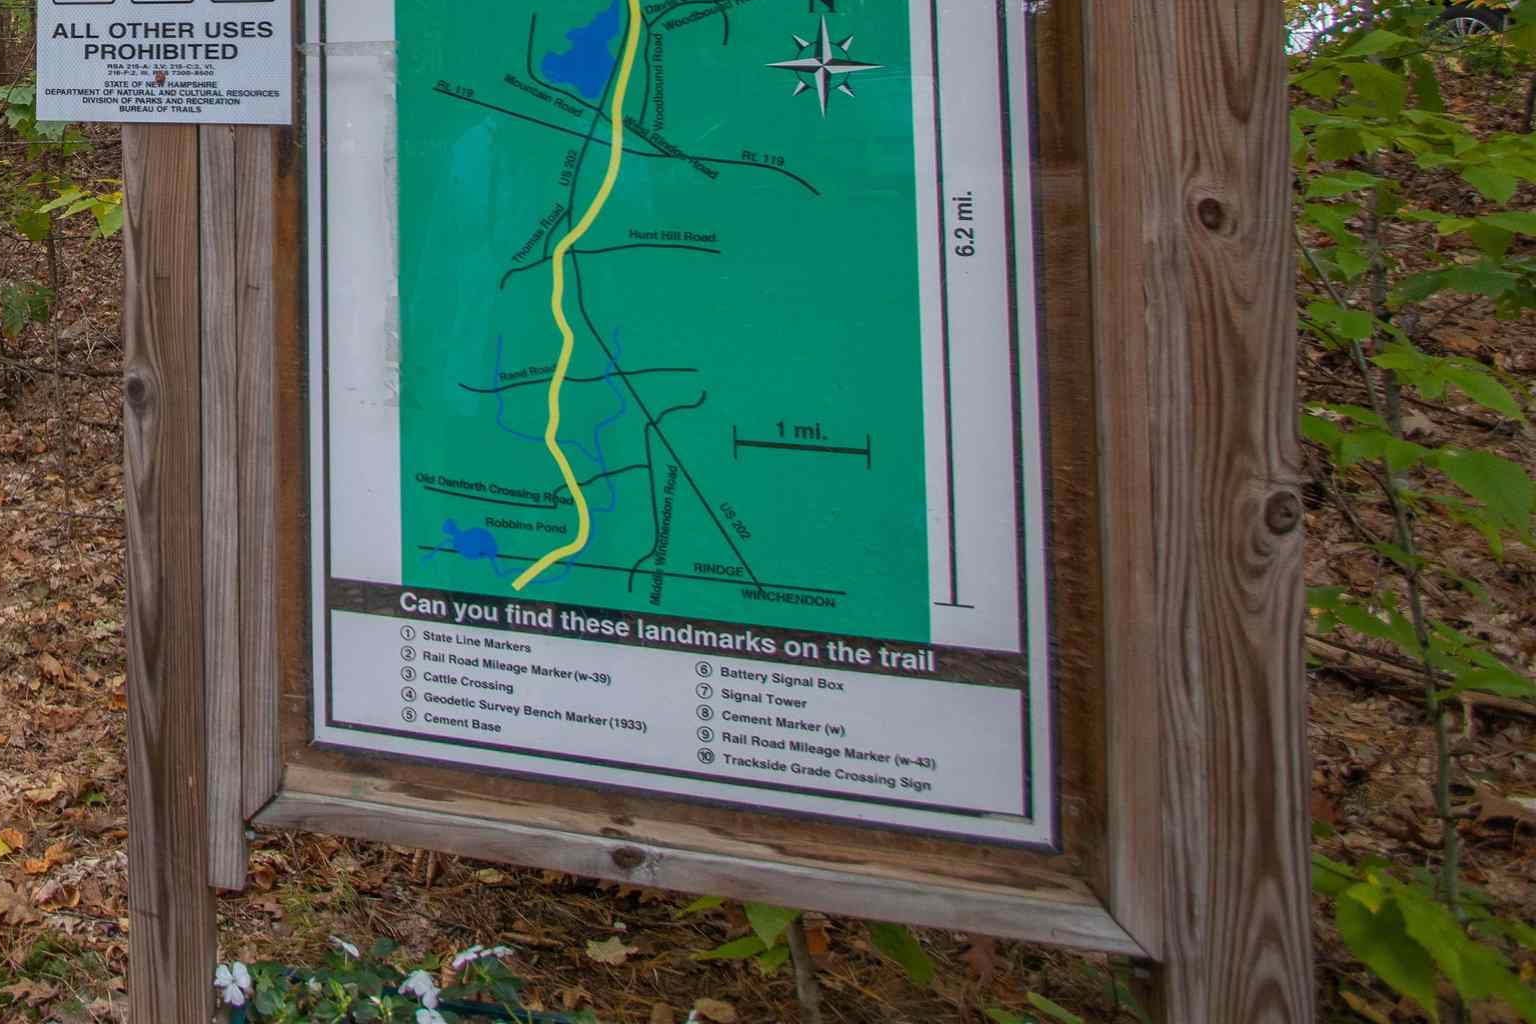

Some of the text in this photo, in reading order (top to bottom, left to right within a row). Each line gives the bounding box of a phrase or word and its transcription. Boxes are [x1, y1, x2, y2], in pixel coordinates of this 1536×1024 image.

[52, 21, 274, 39] ALL OTHER USES
[84, 44, 238, 60] PROHIBITED
[45, 88, 100, 96] DEPARTMENT
[102, 88, 115, 96] OF
[117, 88, 155, 96] NATURAL
[179, 89, 224, 97] CULTURAL
[165, 97, 183, 105] AND
[186, 97, 240, 105] RECREATION
[119, 105, 202, 113] BUREAU OF TRAILS
[553, 97, 583, 118] Road
[565, 150, 577, 169] 202
[512, 203, 565, 263] Thomas Road
[952, 191, 975, 257] 6.2 mi.
[629, 229, 717, 242] Hunt Hill Road
[776, 421, 827, 440] 1 mi.
[415, 472, 435, 484] Old
[437, 476, 486, 491] Danforth
[488, 484, 541, 502] Crossing
[486, 516, 567, 534] Robbins Pond
[720, 501, 752, 541] US 202
[693, 562, 745, 577] RINDGE
[741, 588, 837, 608] WINCHENDON
[400, 592, 936, 672] Can you find these landmarks on the trail
[422, 630, 452, 645] State
[456, 634, 481, 648] Line
[484, 638, 531, 654] Markers
[422, 651, 445, 664] Rail
[449, 654, 479, 668] Road
[482, 658, 528, 675] Mileage
[531, 664, 573, 679] Marker
[574, 670, 612, 686] (w-39)
[720, 667, 767, 683] Battery
[771, 672, 814, 689] Signal
[817, 678, 844, 691] Box
[423, 672, 457, 686] Cattle
[461, 676, 514, 694] Crossing
[721, 688, 762, 704] Signal
[766, 694, 807, 708] Tower
[423, 692, 476, 709] Geodetic
[479, 699, 520, 716] Survey
[524, 705, 562, 721] Bench
[565, 711, 607, 726] Marker
[609, 717, 647, 733] (1933)
[423, 713, 469, 728] Cement
[472, 718, 502, 733] Base
[721, 710, 772, 726] Cement
[776, 717, 821, 732] Marker
[824, 722, 846, 738] (w)
[722, 731, 747, 746] Rail
[751, 735, 785, 750] Road
[789, 741, 841, 759] Mileage
[844, 747, 890, 763] Marker
[894, 753, 936, 770] (w-43)
[723, 754, 787, 772] Trackside
[790, 762, 831, 778] Grade
[835, 768, 896, 788] Crossing
[900, 777, 932, 792] Sign
